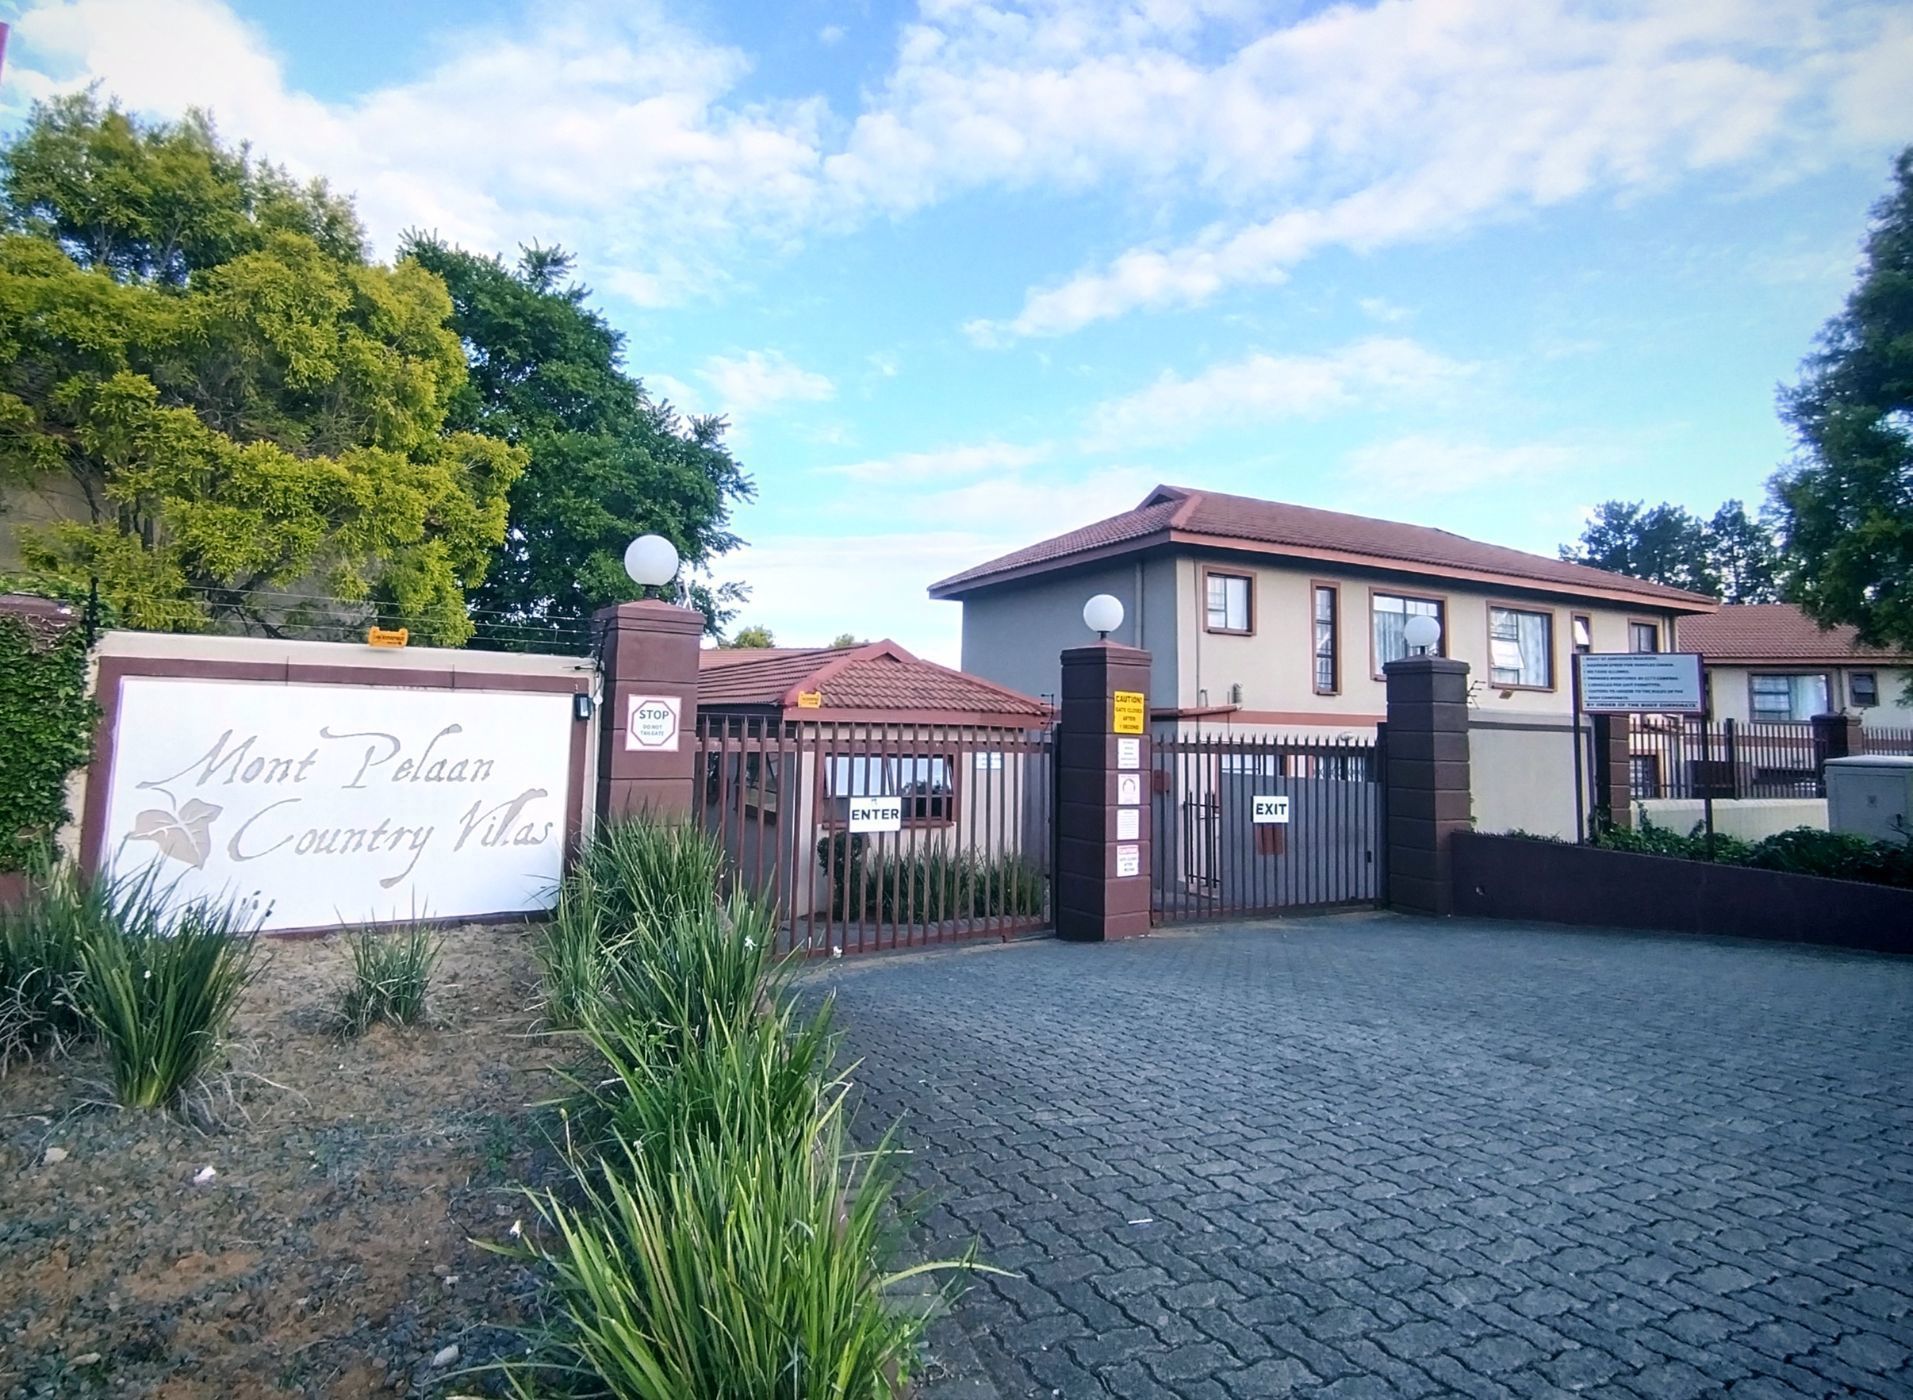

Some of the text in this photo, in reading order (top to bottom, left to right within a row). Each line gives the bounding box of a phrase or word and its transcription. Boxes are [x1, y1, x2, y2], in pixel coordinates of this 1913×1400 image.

[639, 709, 670, 720] STOP
[136, 723, 494, 788] Mont Pelaan
[852, 808, 899, 820] ENTER
[1256, 803, 1287, 815] EXIT
[227, 788, 553, 889] Country Villas
